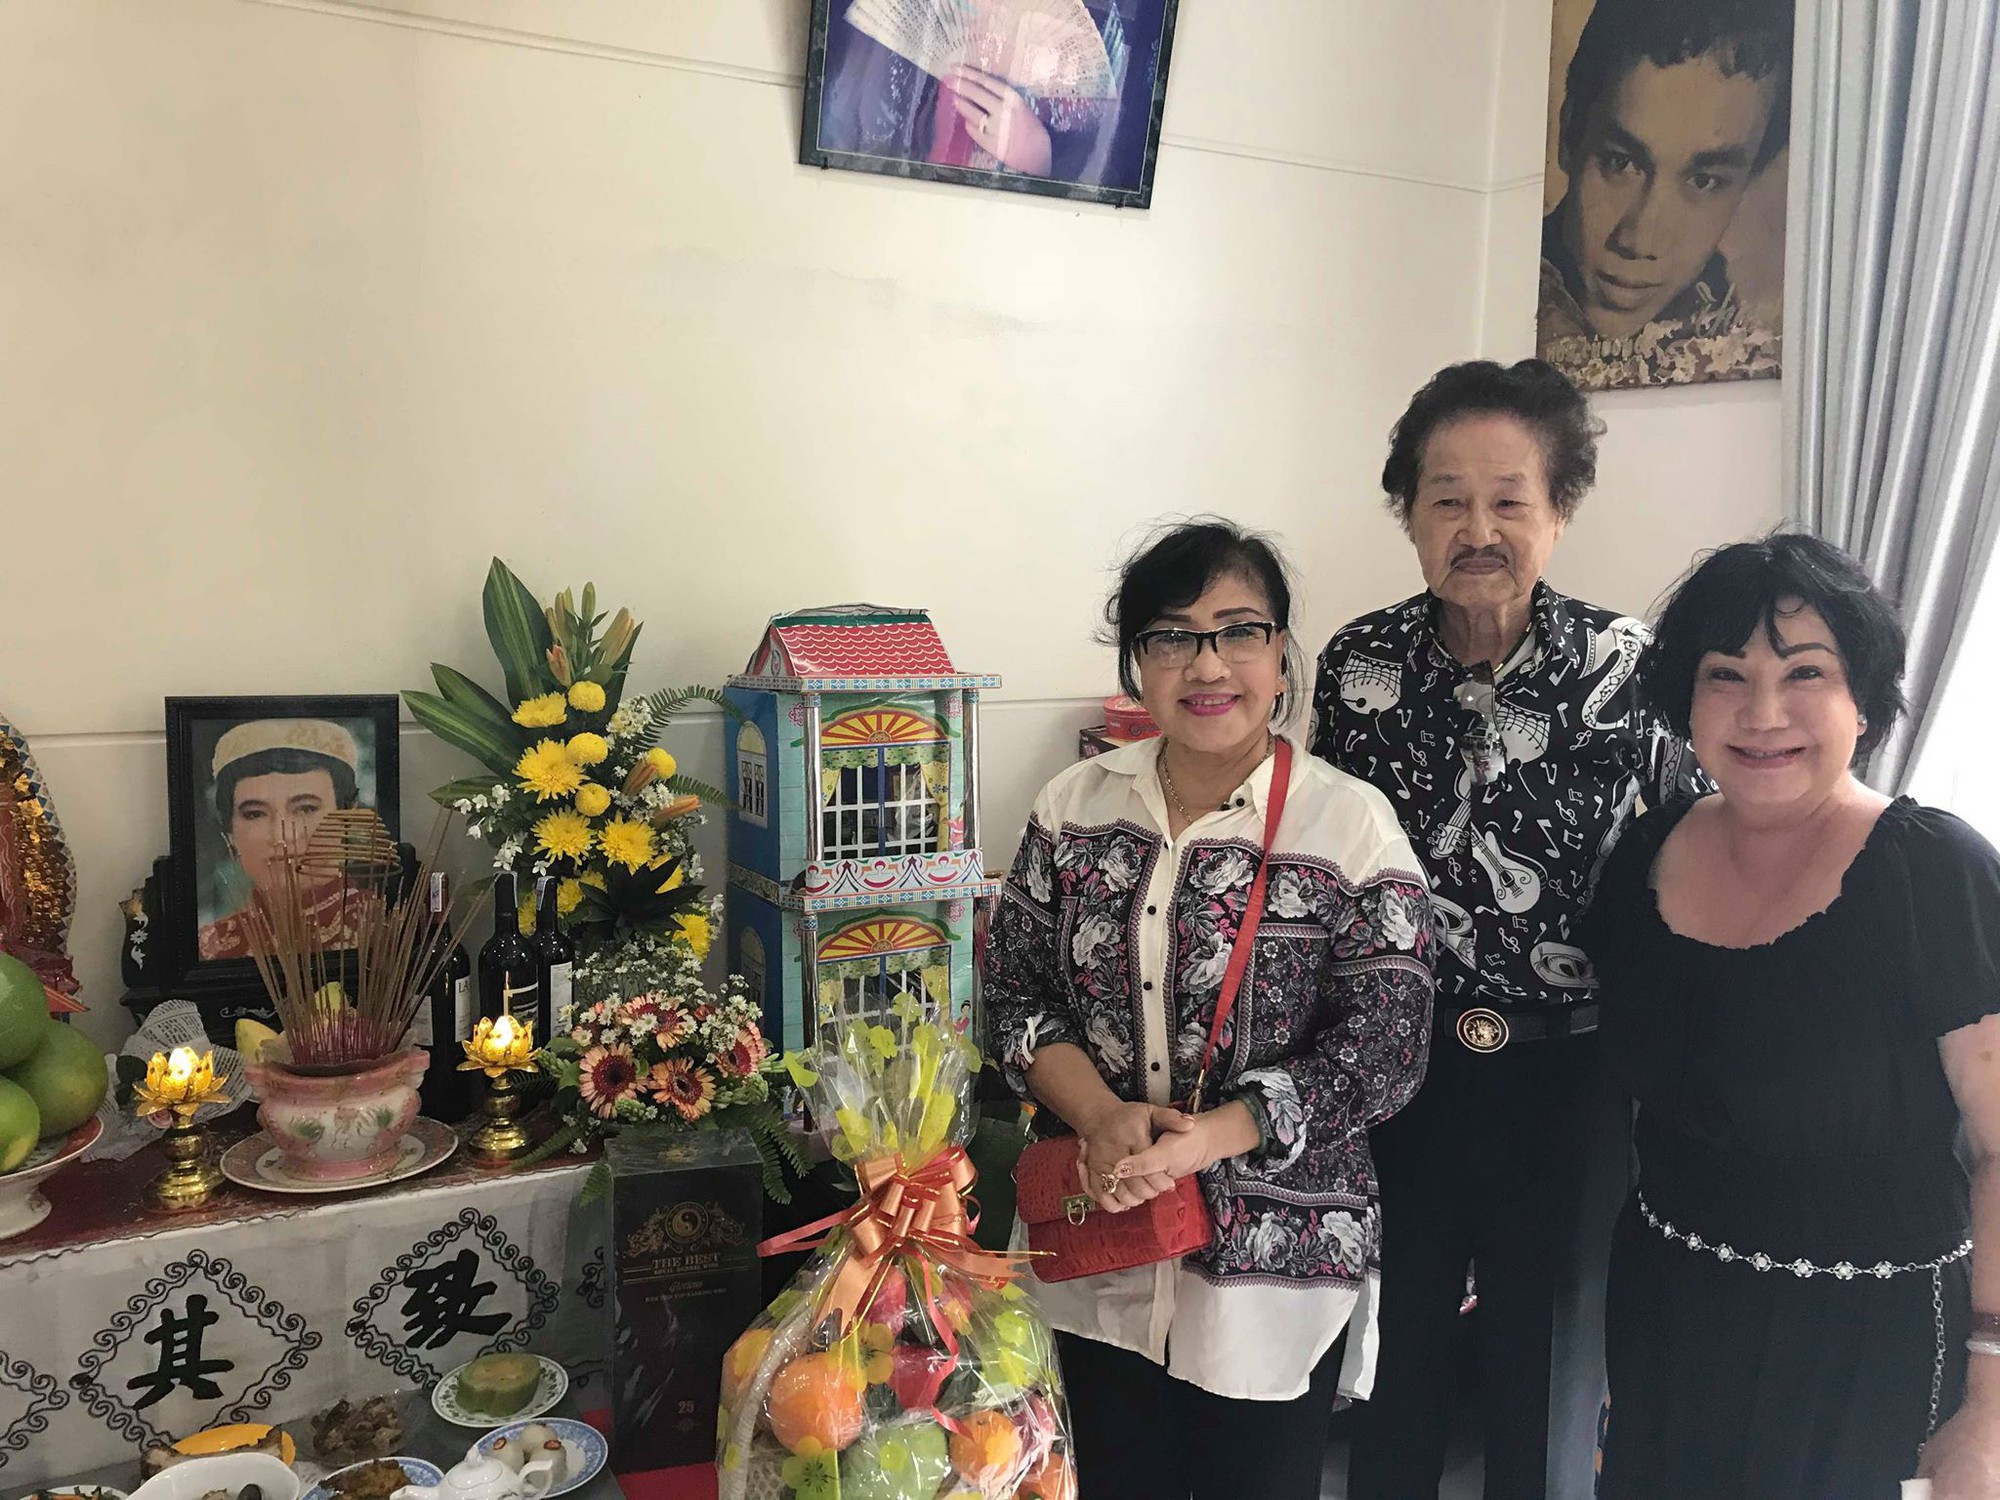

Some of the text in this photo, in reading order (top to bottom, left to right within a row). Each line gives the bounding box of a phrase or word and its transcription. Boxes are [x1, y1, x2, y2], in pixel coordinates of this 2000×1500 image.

[652, 1252, 720, 1269] THE BEST
[127, 1293, 234, 1411] 其
